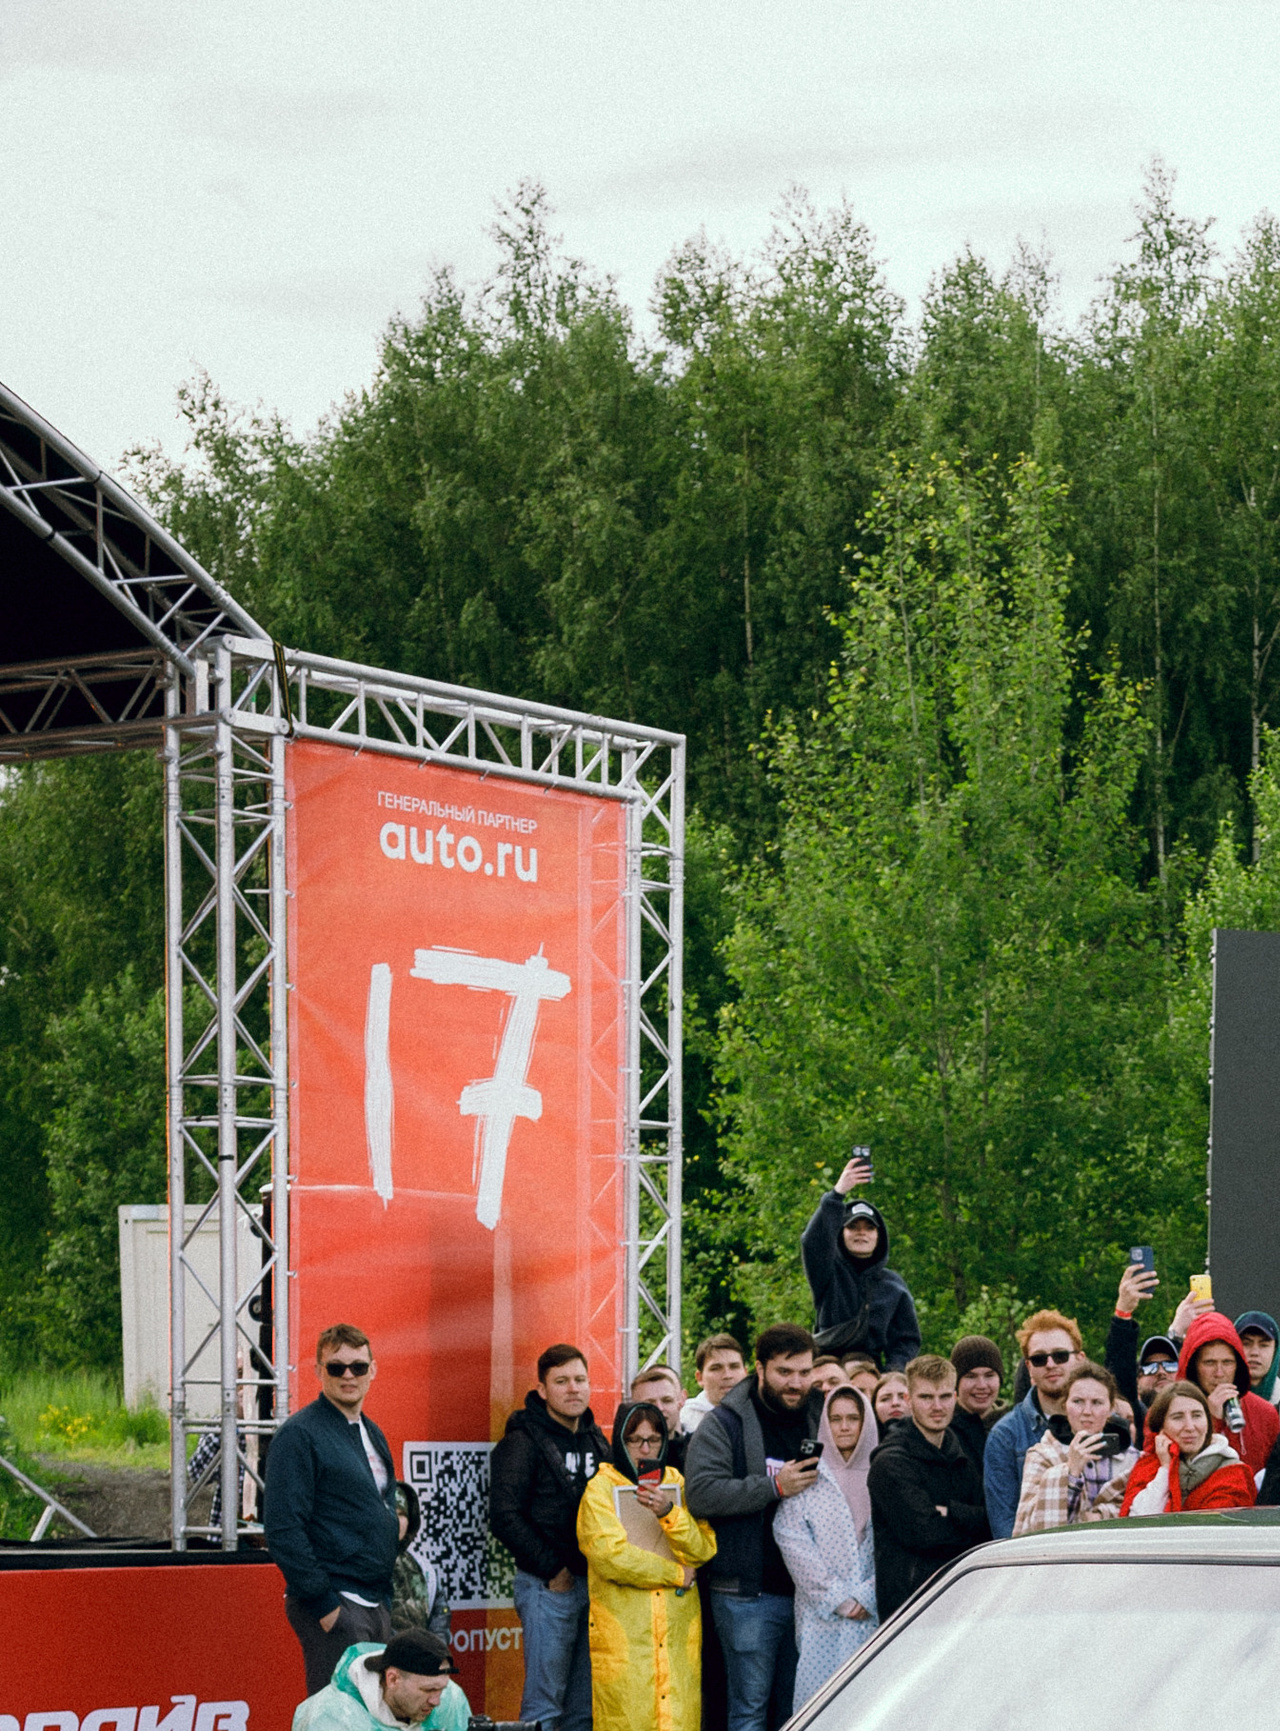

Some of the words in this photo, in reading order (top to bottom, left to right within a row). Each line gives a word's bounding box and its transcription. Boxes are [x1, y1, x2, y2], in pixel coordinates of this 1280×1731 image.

[377, 790, 475, 824] ГЕНЕРАЛЬНЫЙ
[477, 809, 538, 835] ПАРТНЕР
[378, 820, 539, 883] auto.ru
[363, 941, 573, 1231] 17
